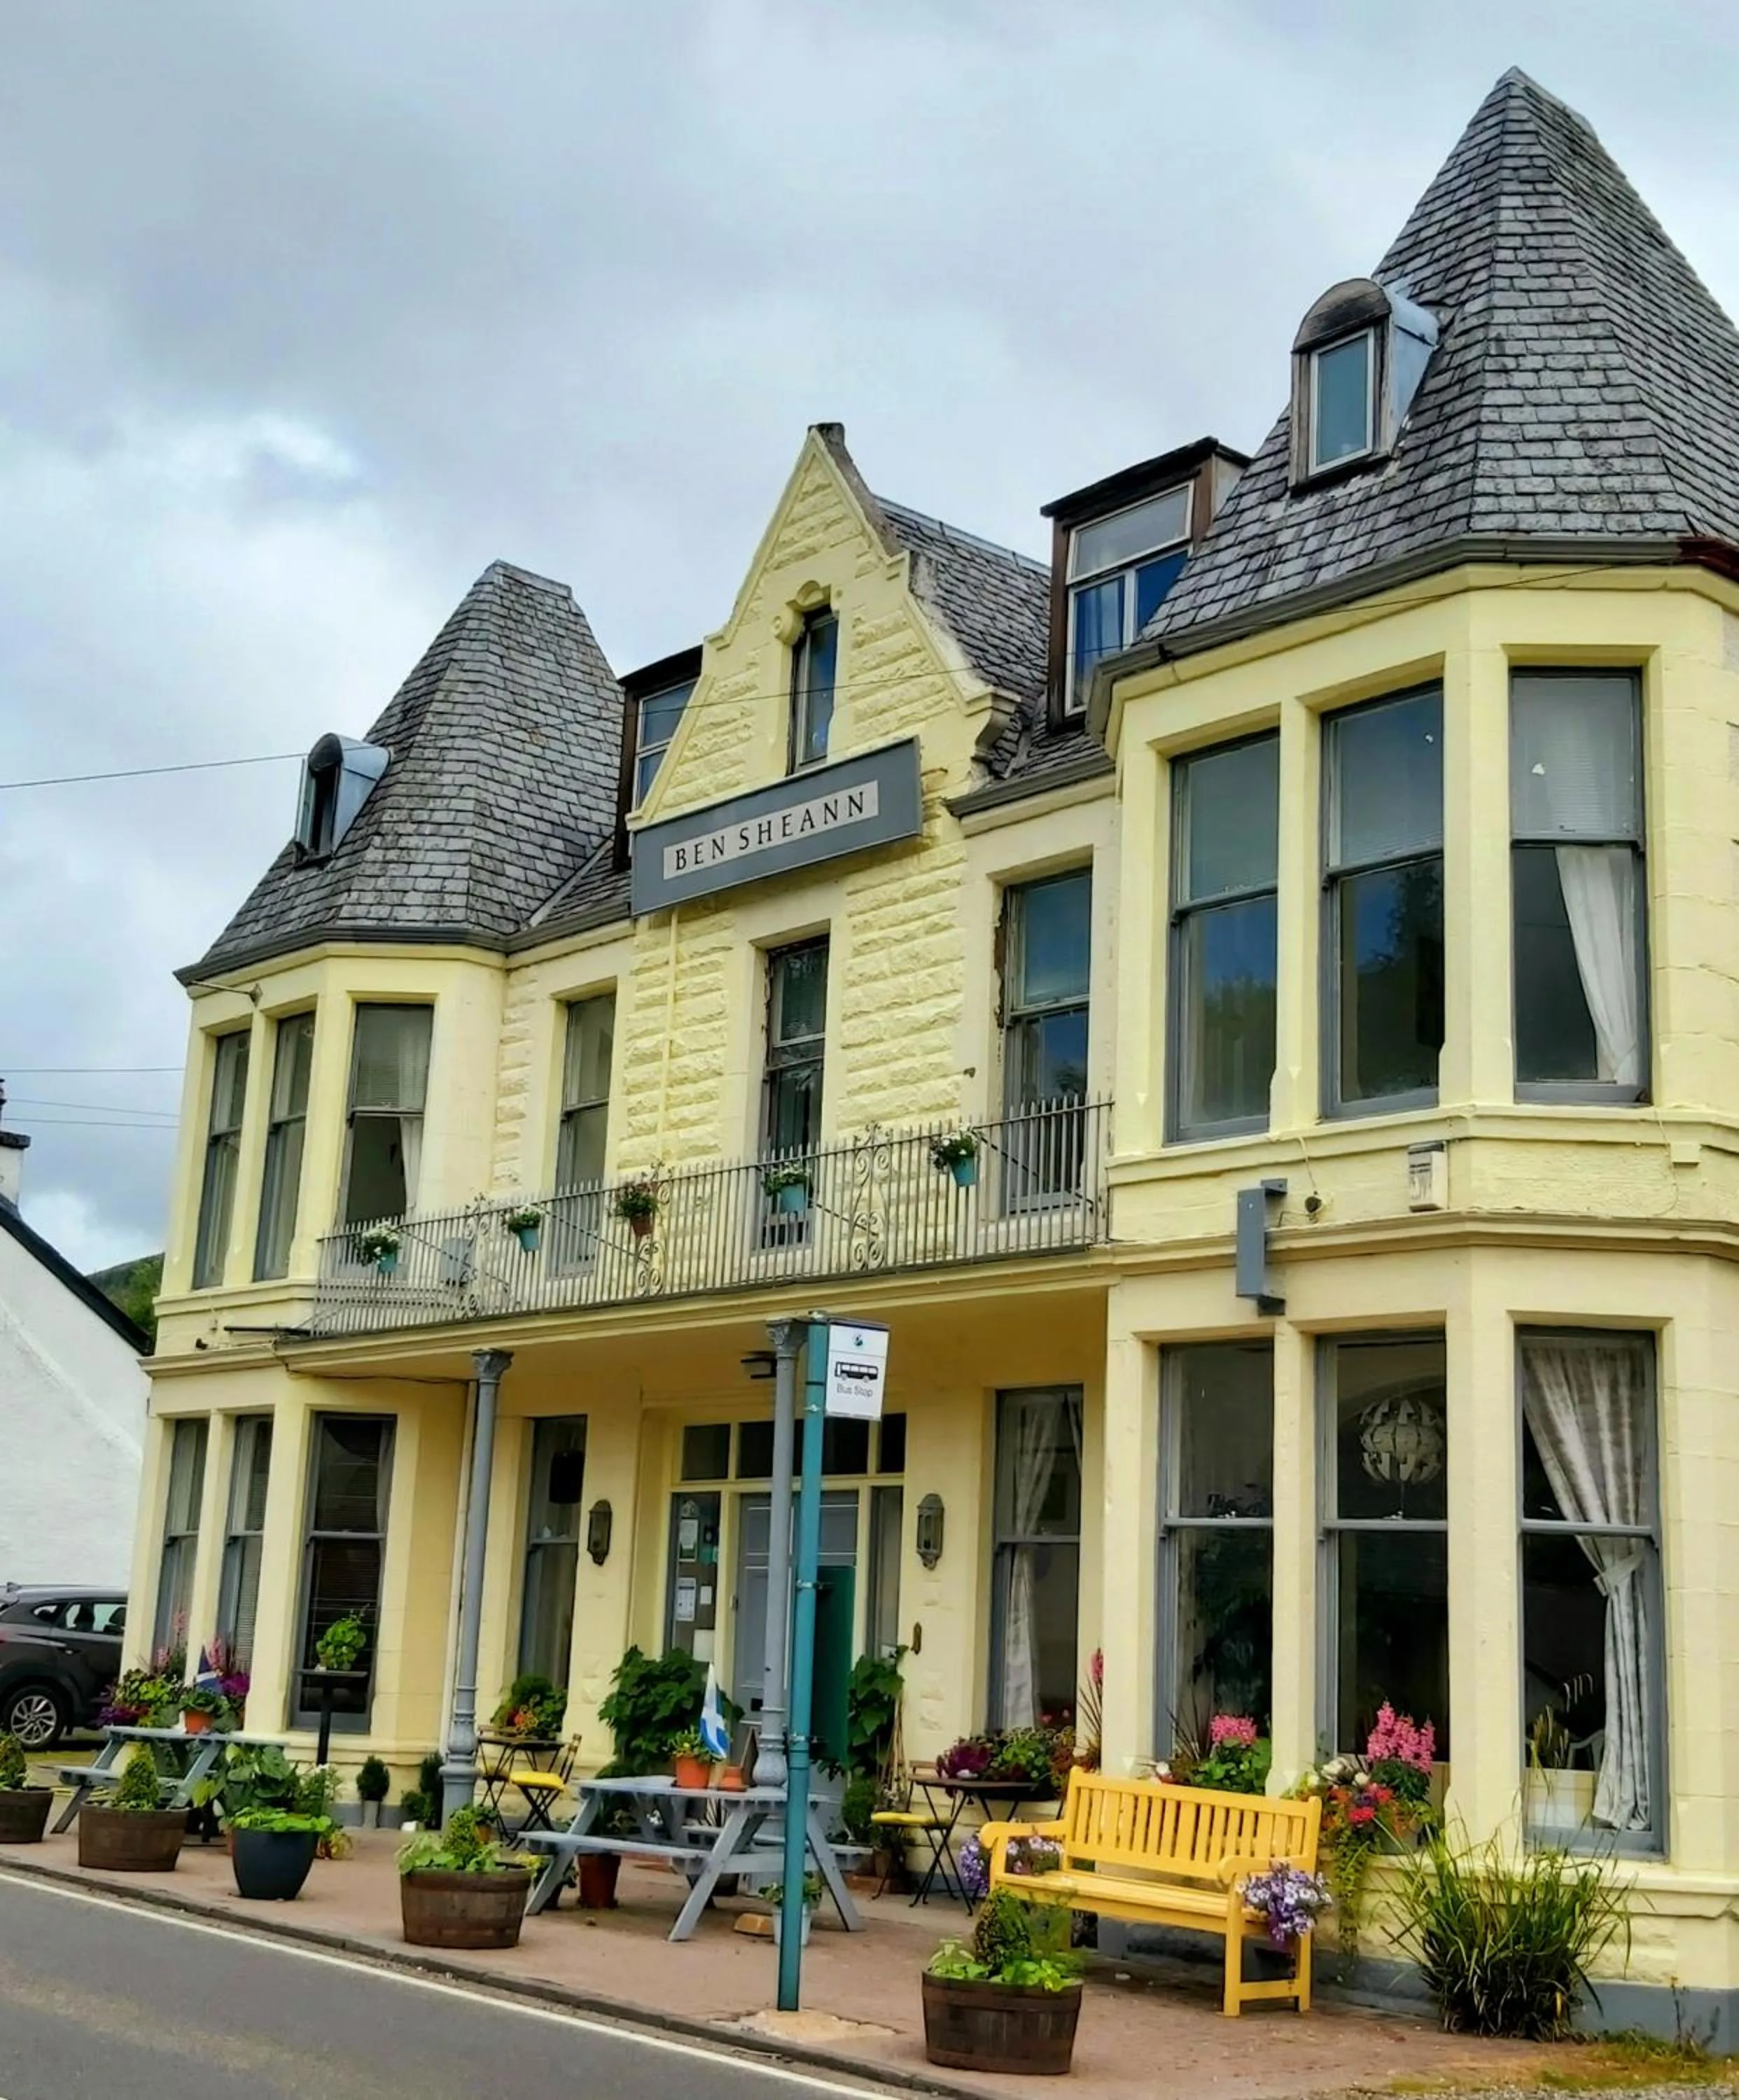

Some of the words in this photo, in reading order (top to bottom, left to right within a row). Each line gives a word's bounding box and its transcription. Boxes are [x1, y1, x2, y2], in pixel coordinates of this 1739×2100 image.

[675, 835, 726, 871] BEN
[739, 791, 865, 850] SHEANN
[837, 1383, 852, 1394] Bus
[854, 1385, 873, 1398] Stop
